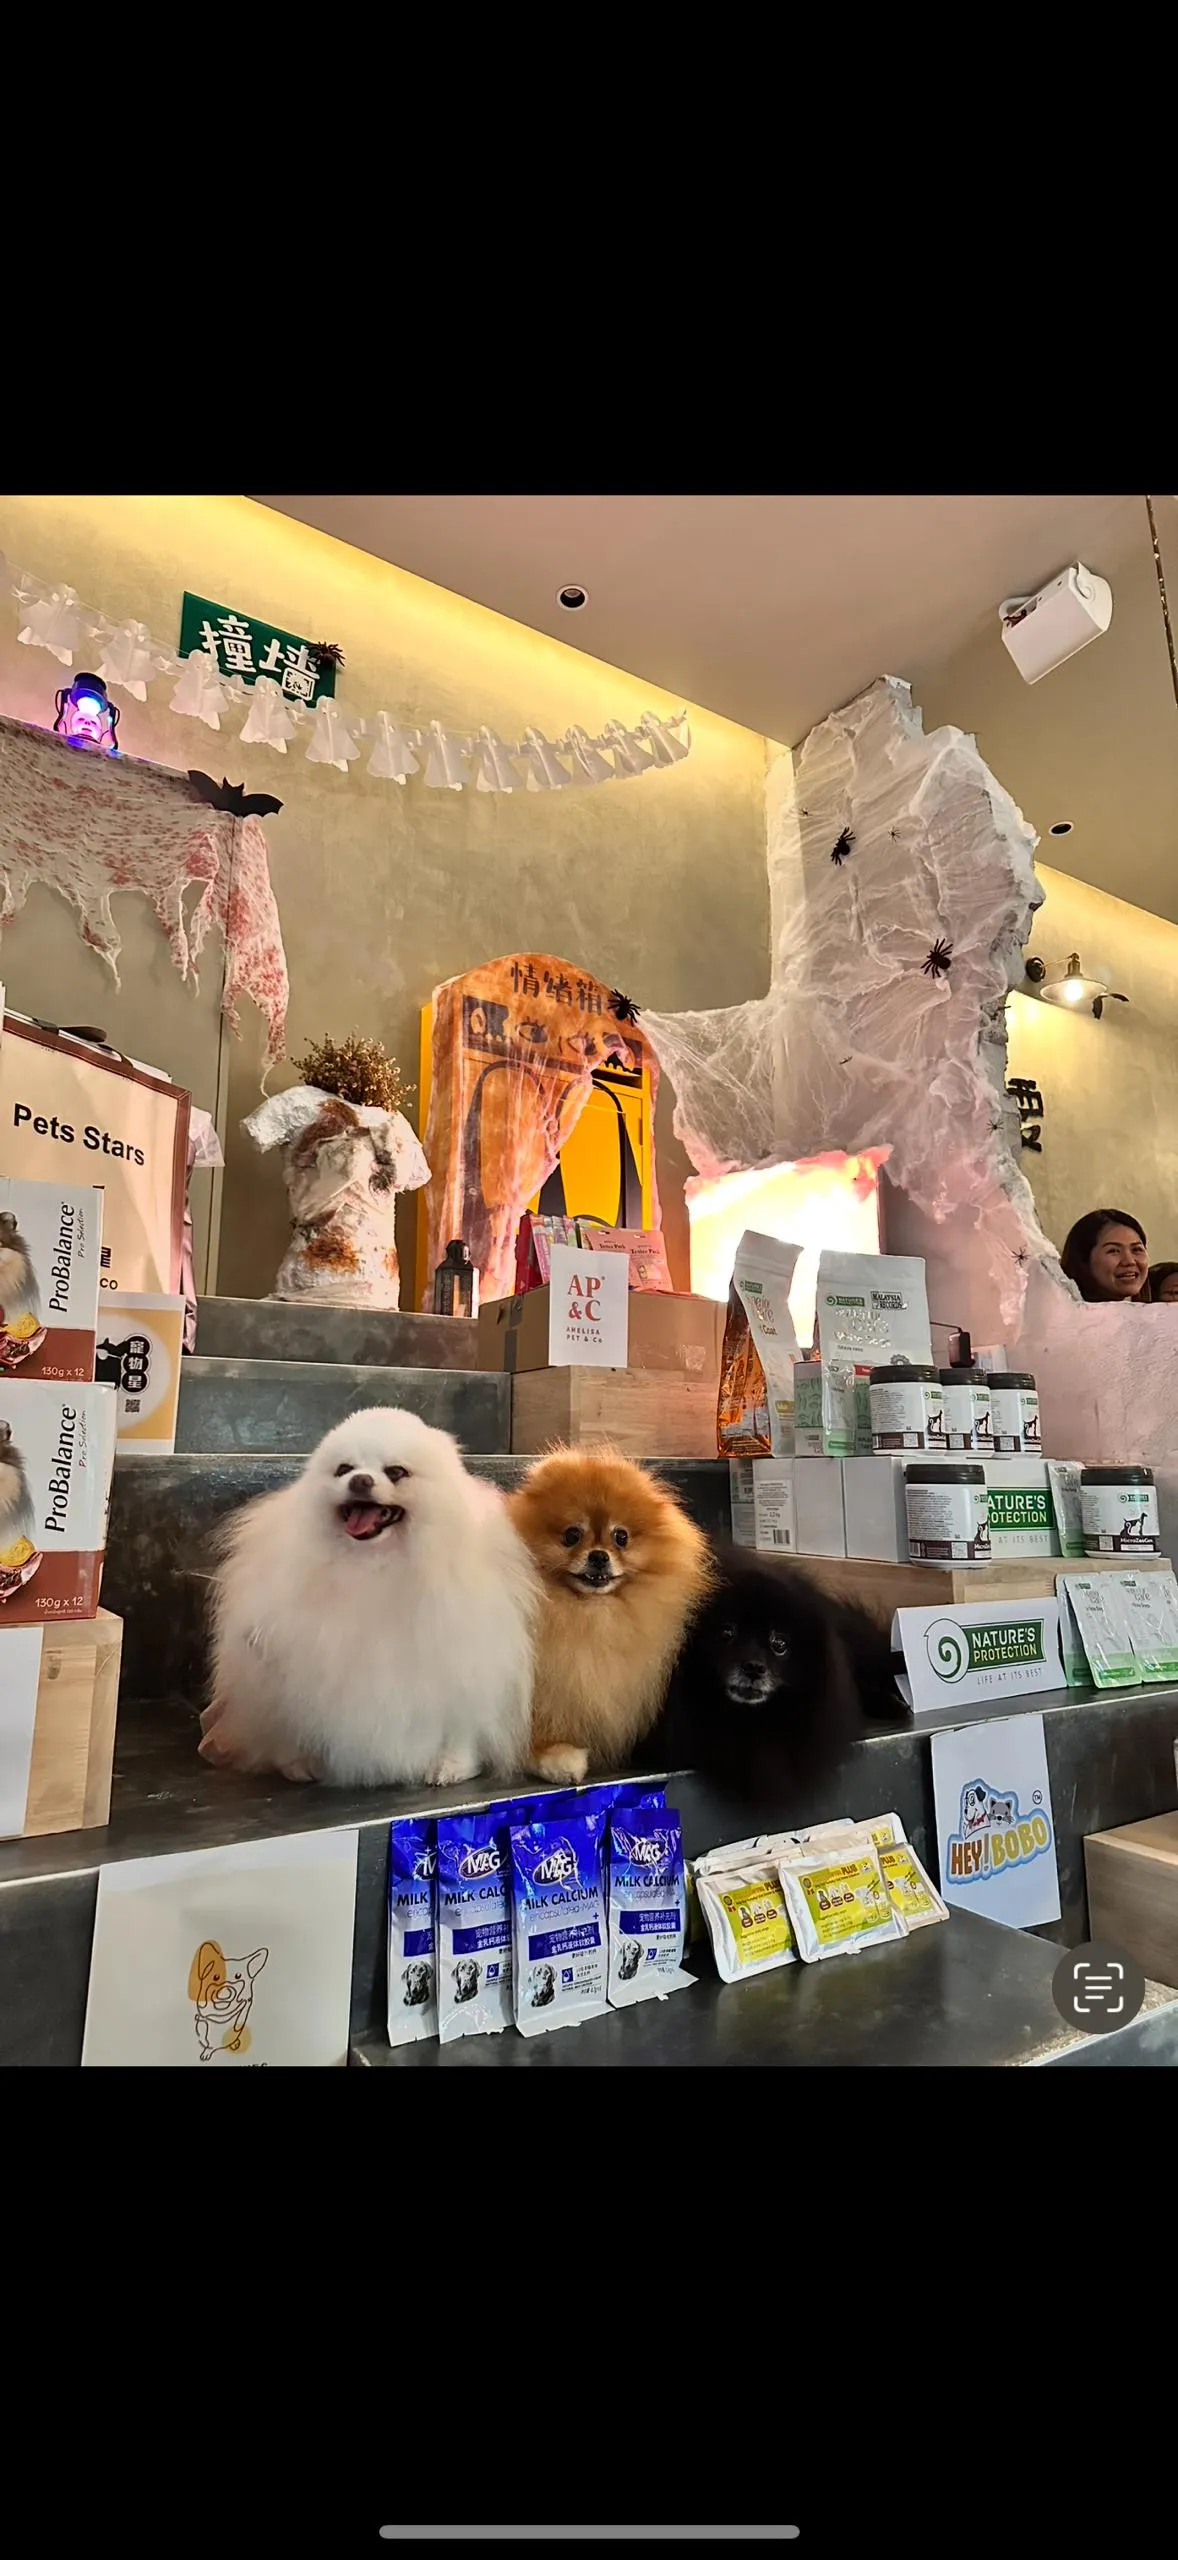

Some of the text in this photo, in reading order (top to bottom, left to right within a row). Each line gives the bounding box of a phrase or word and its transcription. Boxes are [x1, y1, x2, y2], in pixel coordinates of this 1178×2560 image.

[13, 1103, 145, 1166] Pets Stars
[49, 1203, 75, 1312] ProBalance
[567, 1274, 601, 1298] AP
[41, 1366, 64, 1377] 130g
[73, 1367, 85, 1377] 12
[45, 1406, 77, 1532] ProBalance
[988, 1495, 1046, 1510] ATURE'S
[990, 1512, 1047, 1523] OTECTION
[35, 1596, 83, 1609] 130g x 12
[971, 1627, 1036, 1649] NATURE'S
[973, 1644, 1037, 1663] PROTECTION
[977, 1667, 1042, 1685] LIFE AT ITS BEST
[991, 1817, 1047, 1866] BOBO
[615, 1875, 640, 1888] MILK
[397, 1892, 428, 1906] MILK
[444, 1886, 506, 1906] MILK CALC
[551, 1886, 599, 1906] CALCIUM
